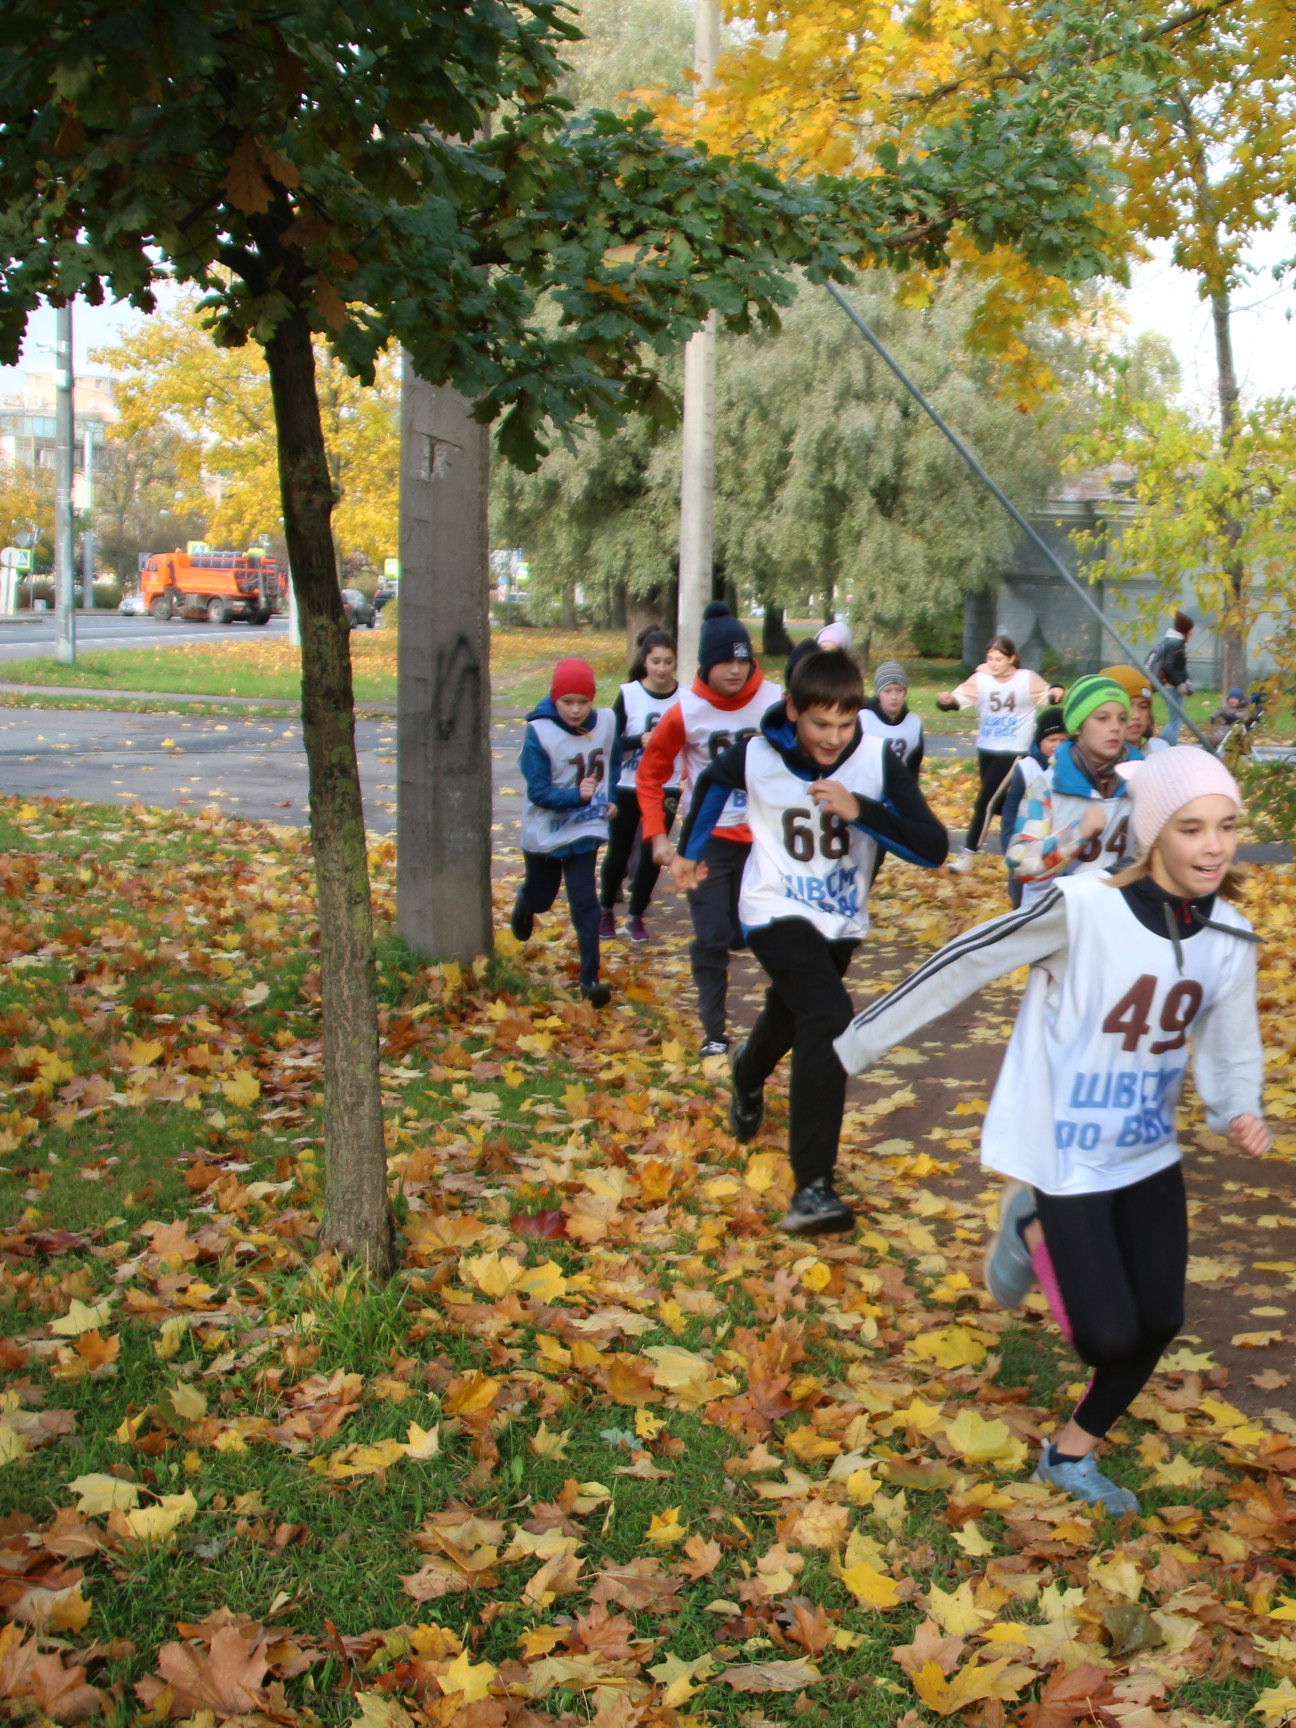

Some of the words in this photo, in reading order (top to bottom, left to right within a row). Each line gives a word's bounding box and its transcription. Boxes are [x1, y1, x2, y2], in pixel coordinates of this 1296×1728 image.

[989, 691, 1017, 712] 54
[781, 807, 850, 863] 68
[1102, 973, 1204, 1055] 49
